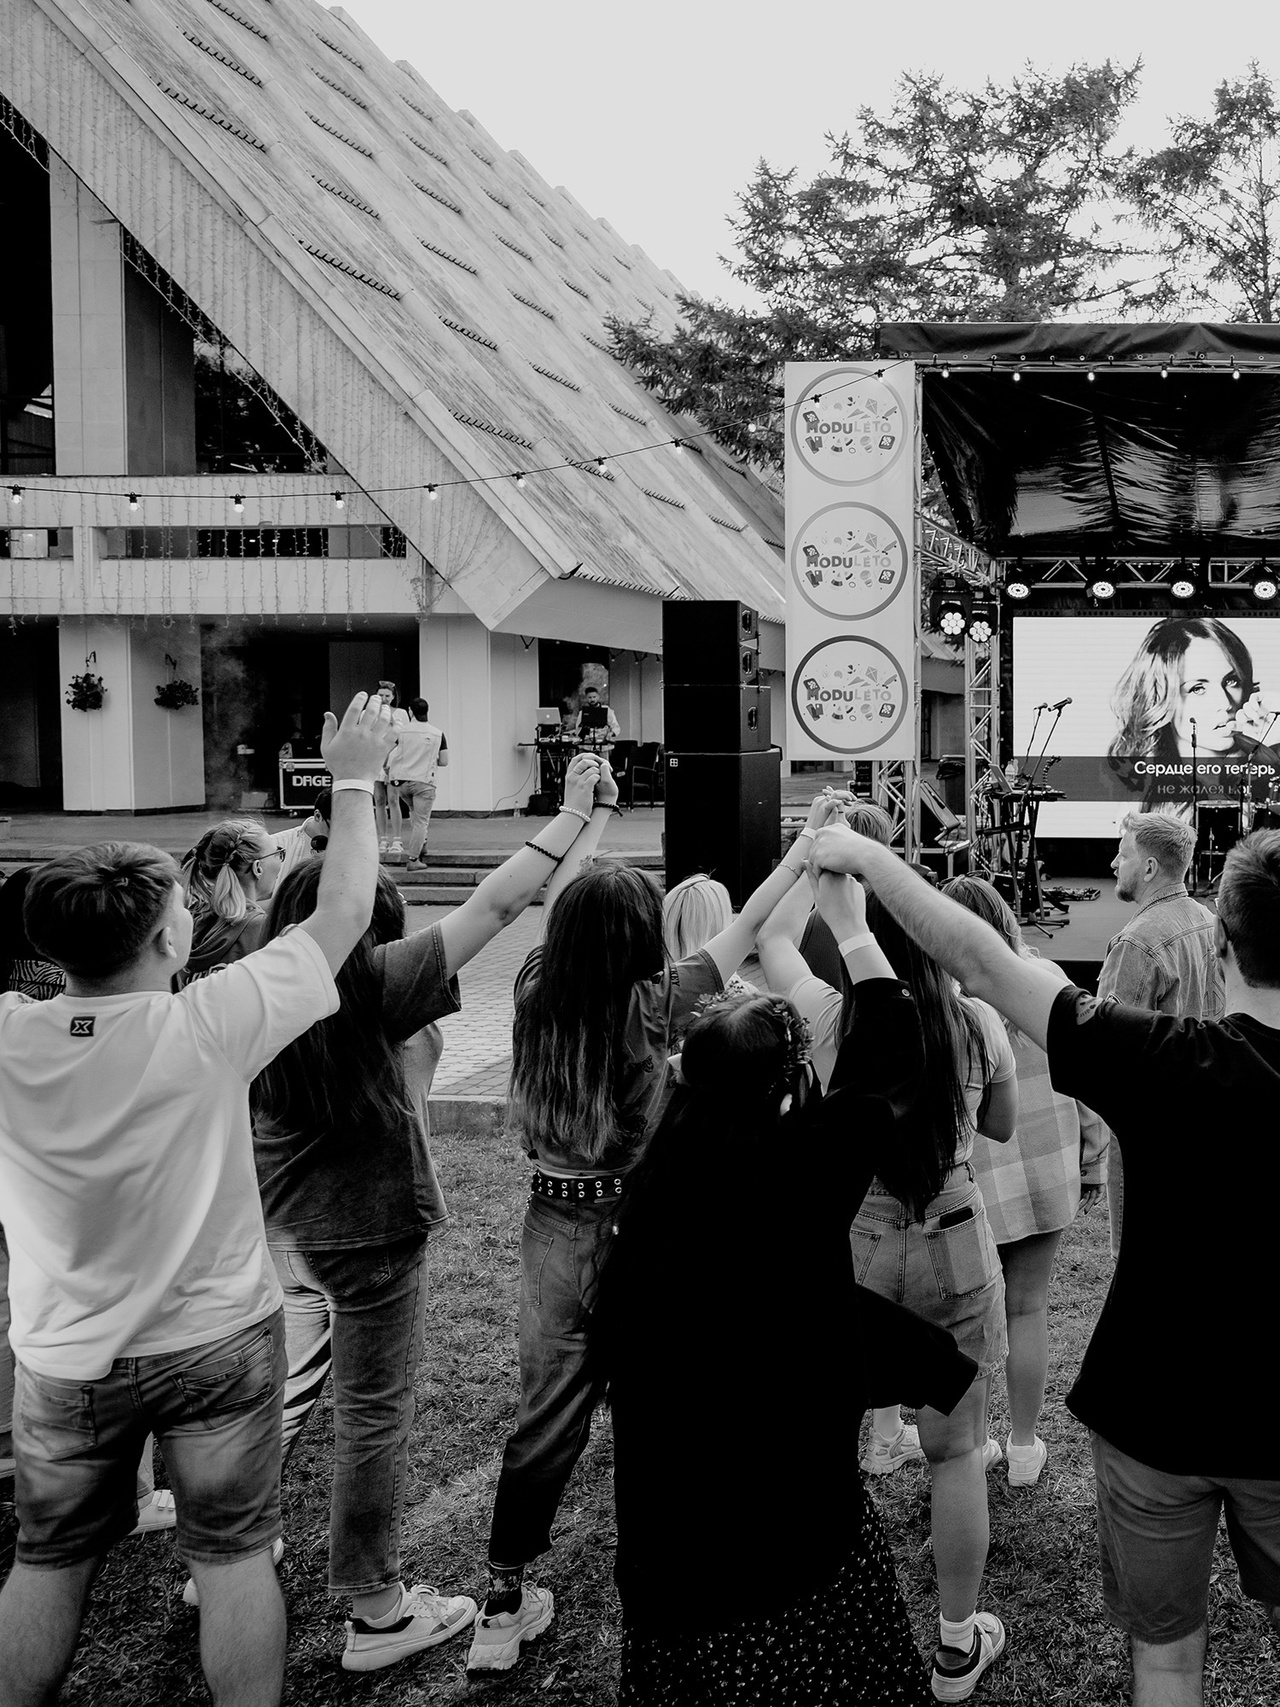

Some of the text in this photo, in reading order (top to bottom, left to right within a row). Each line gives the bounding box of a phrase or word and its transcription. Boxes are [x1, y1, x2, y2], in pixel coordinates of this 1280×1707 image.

[1134, 761, 1193, 777] Сердце
[1196, 764, 1221, 775] его
[1157, 784, 1176, 794] не
